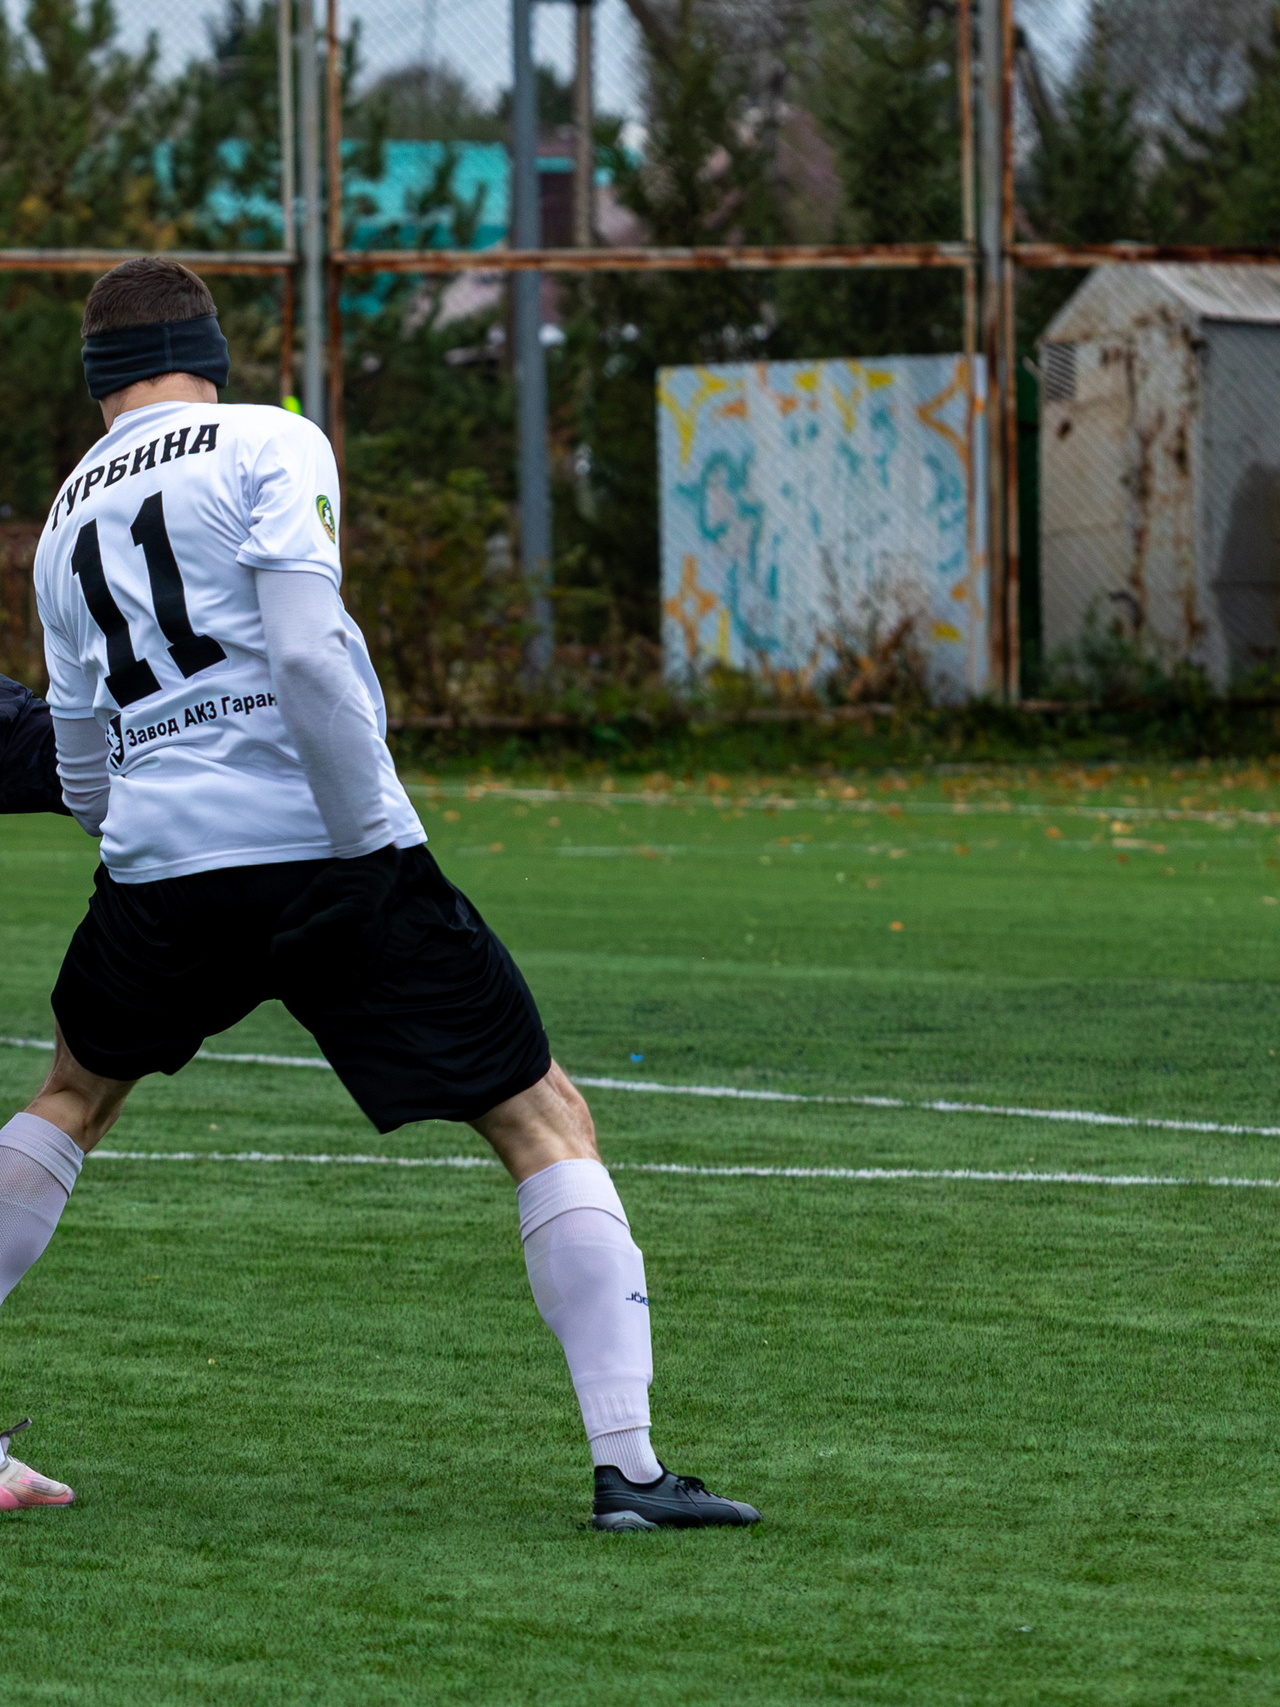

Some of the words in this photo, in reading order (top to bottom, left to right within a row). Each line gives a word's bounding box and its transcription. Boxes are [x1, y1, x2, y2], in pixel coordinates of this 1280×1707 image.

[52, 423, 220, 532] ТУРБИНА
[71, 490, 227, 708] 11
[125, 717, 181, 748] Завод
